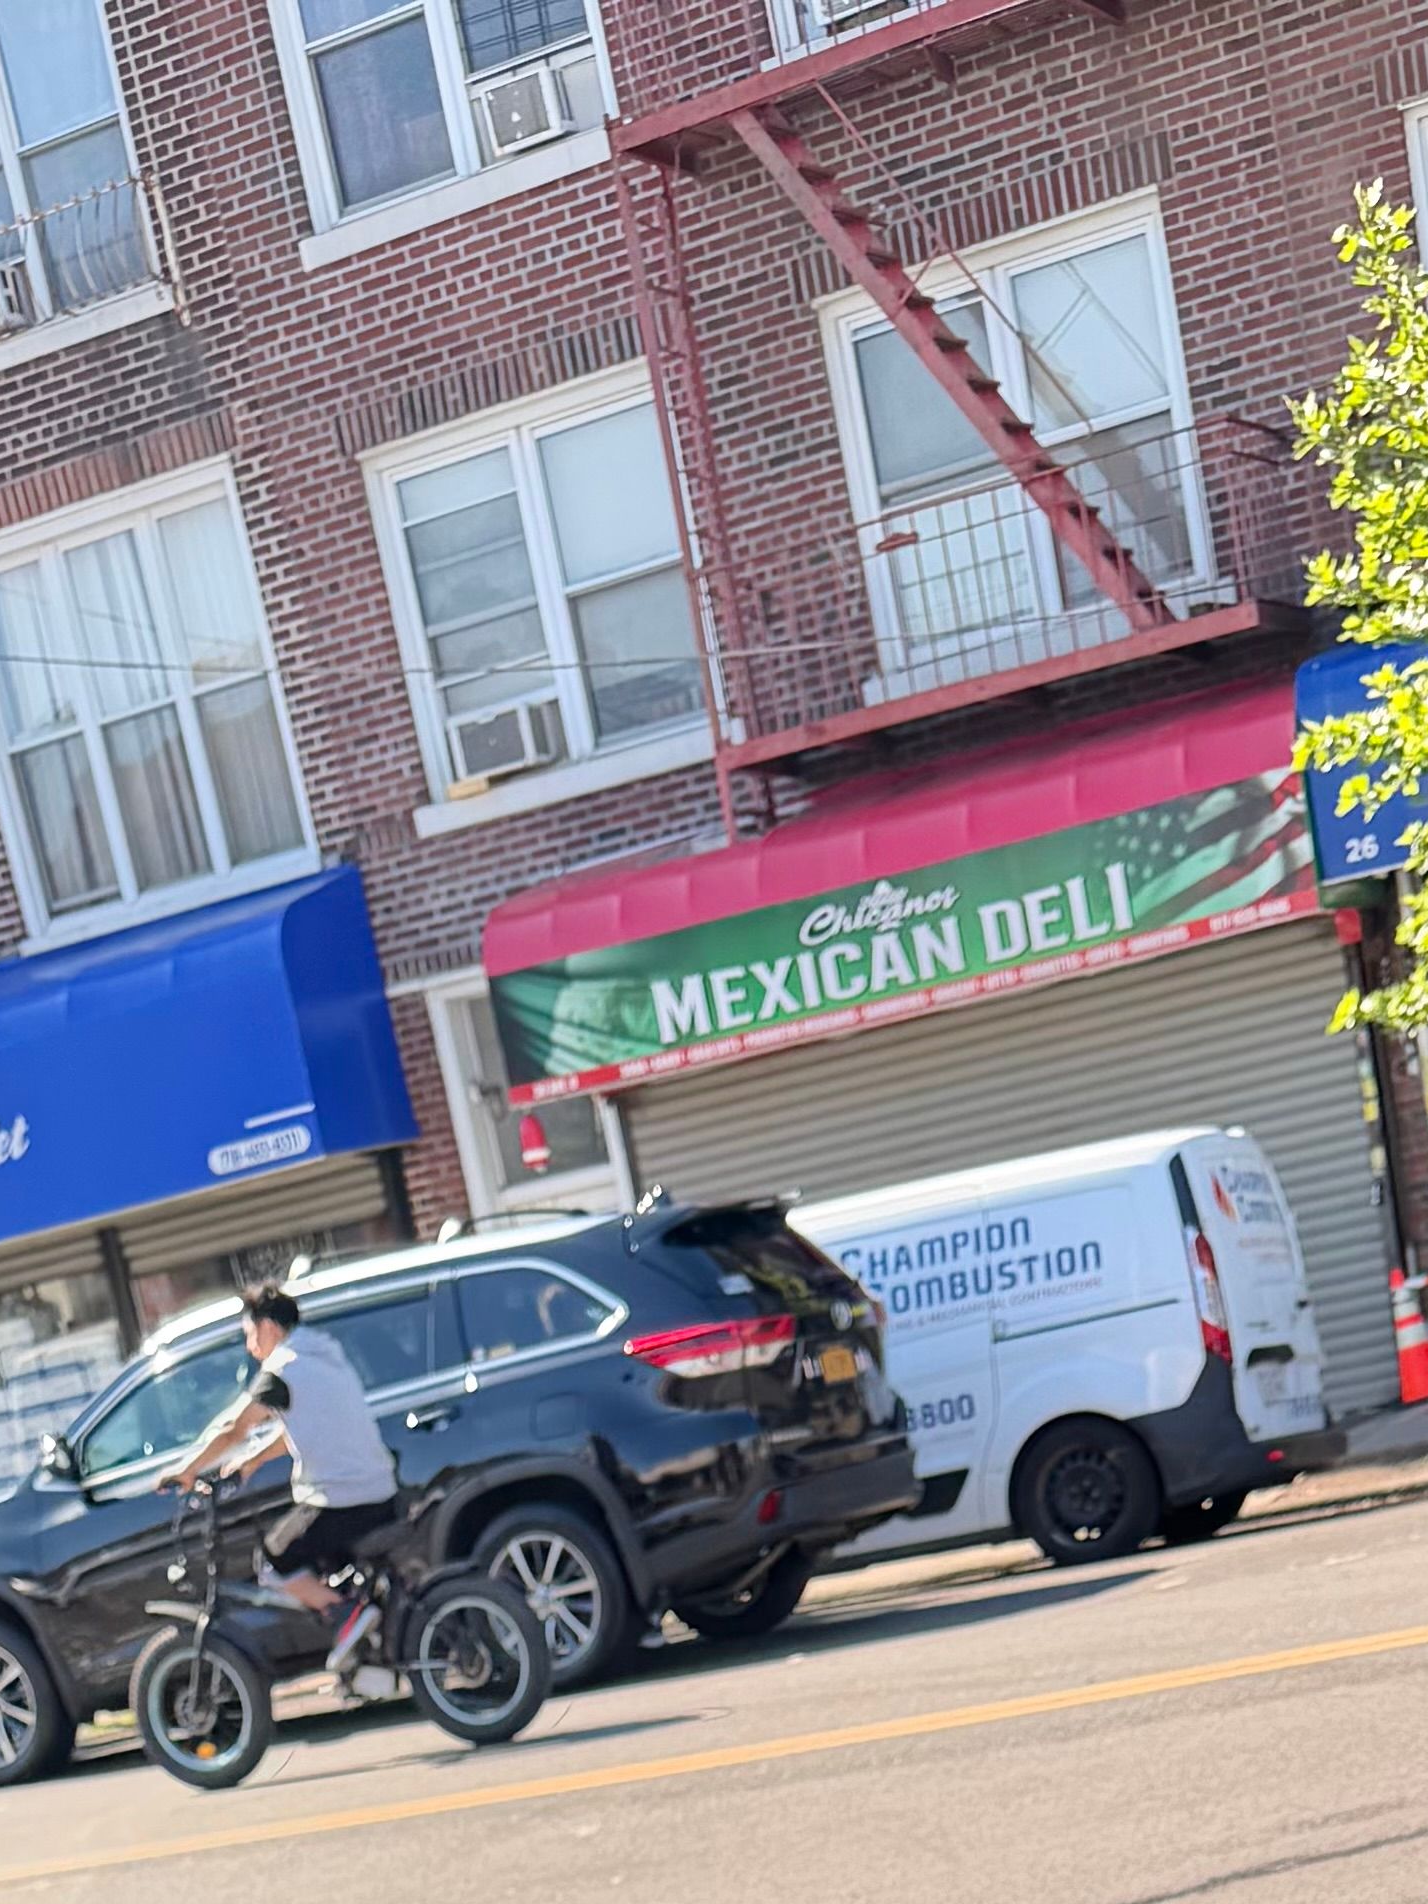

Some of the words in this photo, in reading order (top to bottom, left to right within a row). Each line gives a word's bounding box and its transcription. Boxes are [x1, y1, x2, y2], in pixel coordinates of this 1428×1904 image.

[1345, 834, 1380, 864] 26
[650, 913, 968, 1046] MEXICAN
[977, 860, 1136, 965] DELI
[868, 1240, 1103, 1314] OMBUSTION
